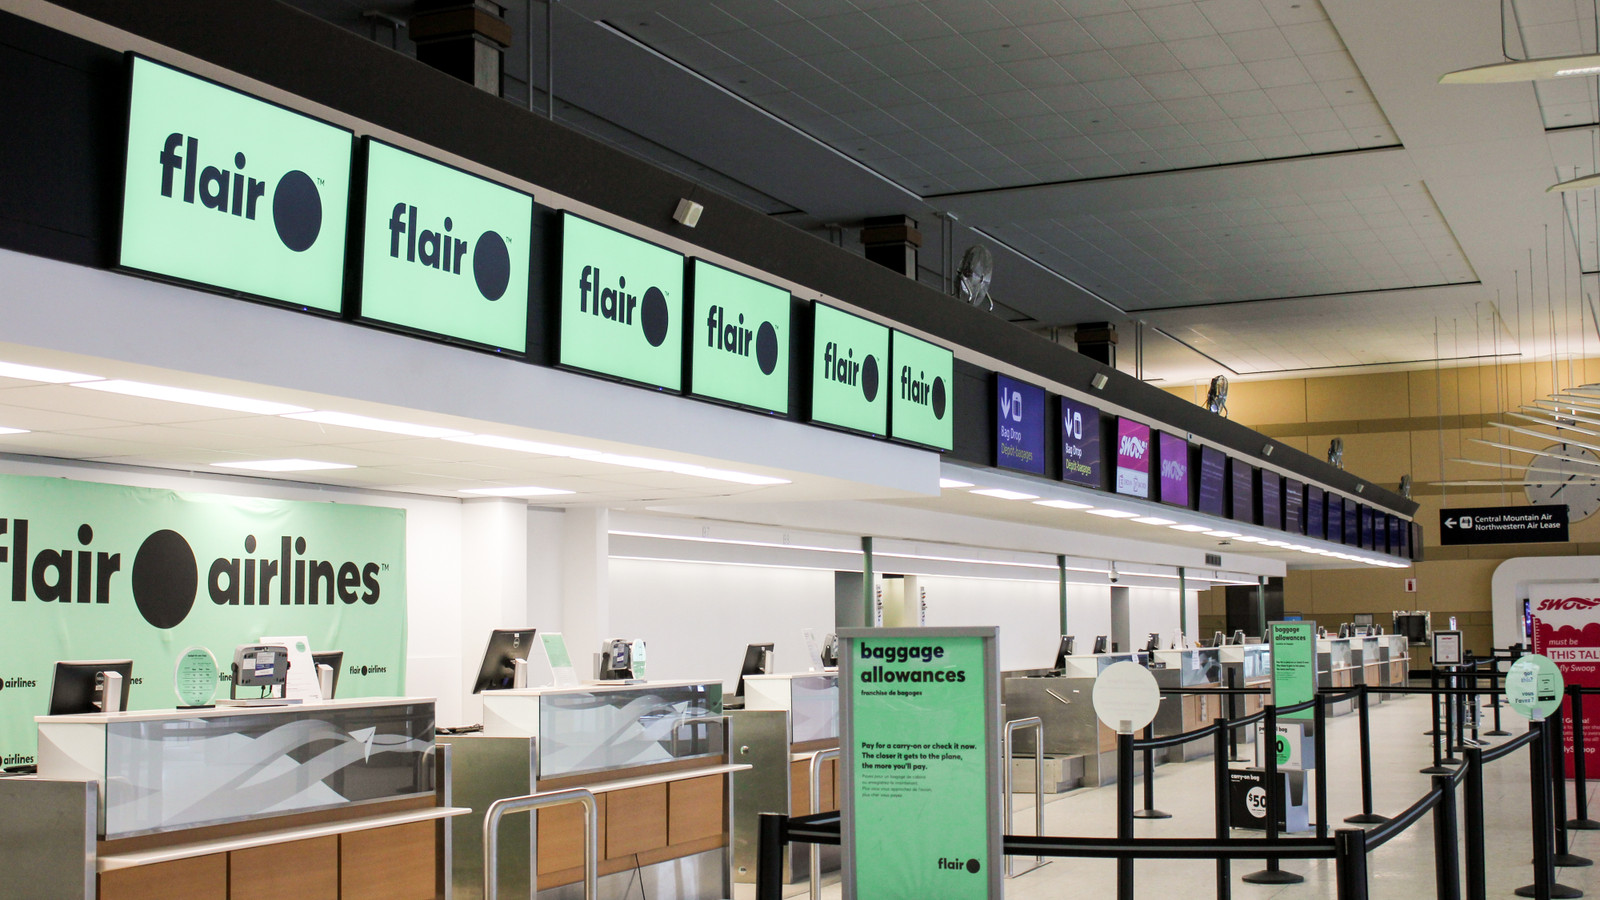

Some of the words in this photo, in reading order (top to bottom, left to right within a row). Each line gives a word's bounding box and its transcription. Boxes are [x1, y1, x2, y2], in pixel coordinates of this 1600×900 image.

[160, 133, 265, 220] flair
[389, 202, 467, 275] flair
[579, 265, 636, 325] flair
[707, 305, 752, 357] flair
[824, 341, 860, 387] flair
[901, 365, 930, 406] flair
[1001, 425, 1010, 441] Bag
[1011, 428, 1021, 443] Drop
[1475, 515, 1501, 523] Central
[1503, 514, 1539, 522] Mountain
[208, 534, 380, 605] airlines
[1275, 626, 1300, 634] baggage
[861, 642, 944, 663] baggage
[1549, 650, 1576, 660] THIS
[1578, 650, 1600, 659] TAL
[1570, 664, 1595, 672] Swoop
[861, 666, 966, 683] allowances
[5, 677, 36, 688] airlines
[862, 742, 874, 750] Pay
[4, 754, 34, 764] airlines
[904, 753, 918, 761] gets
[941, 753, 962, 761] plane,
[894, 762, 911, 770] you'll
[1251, 774, 1260, 782] bag
[938, 858, 964, 870] flair
